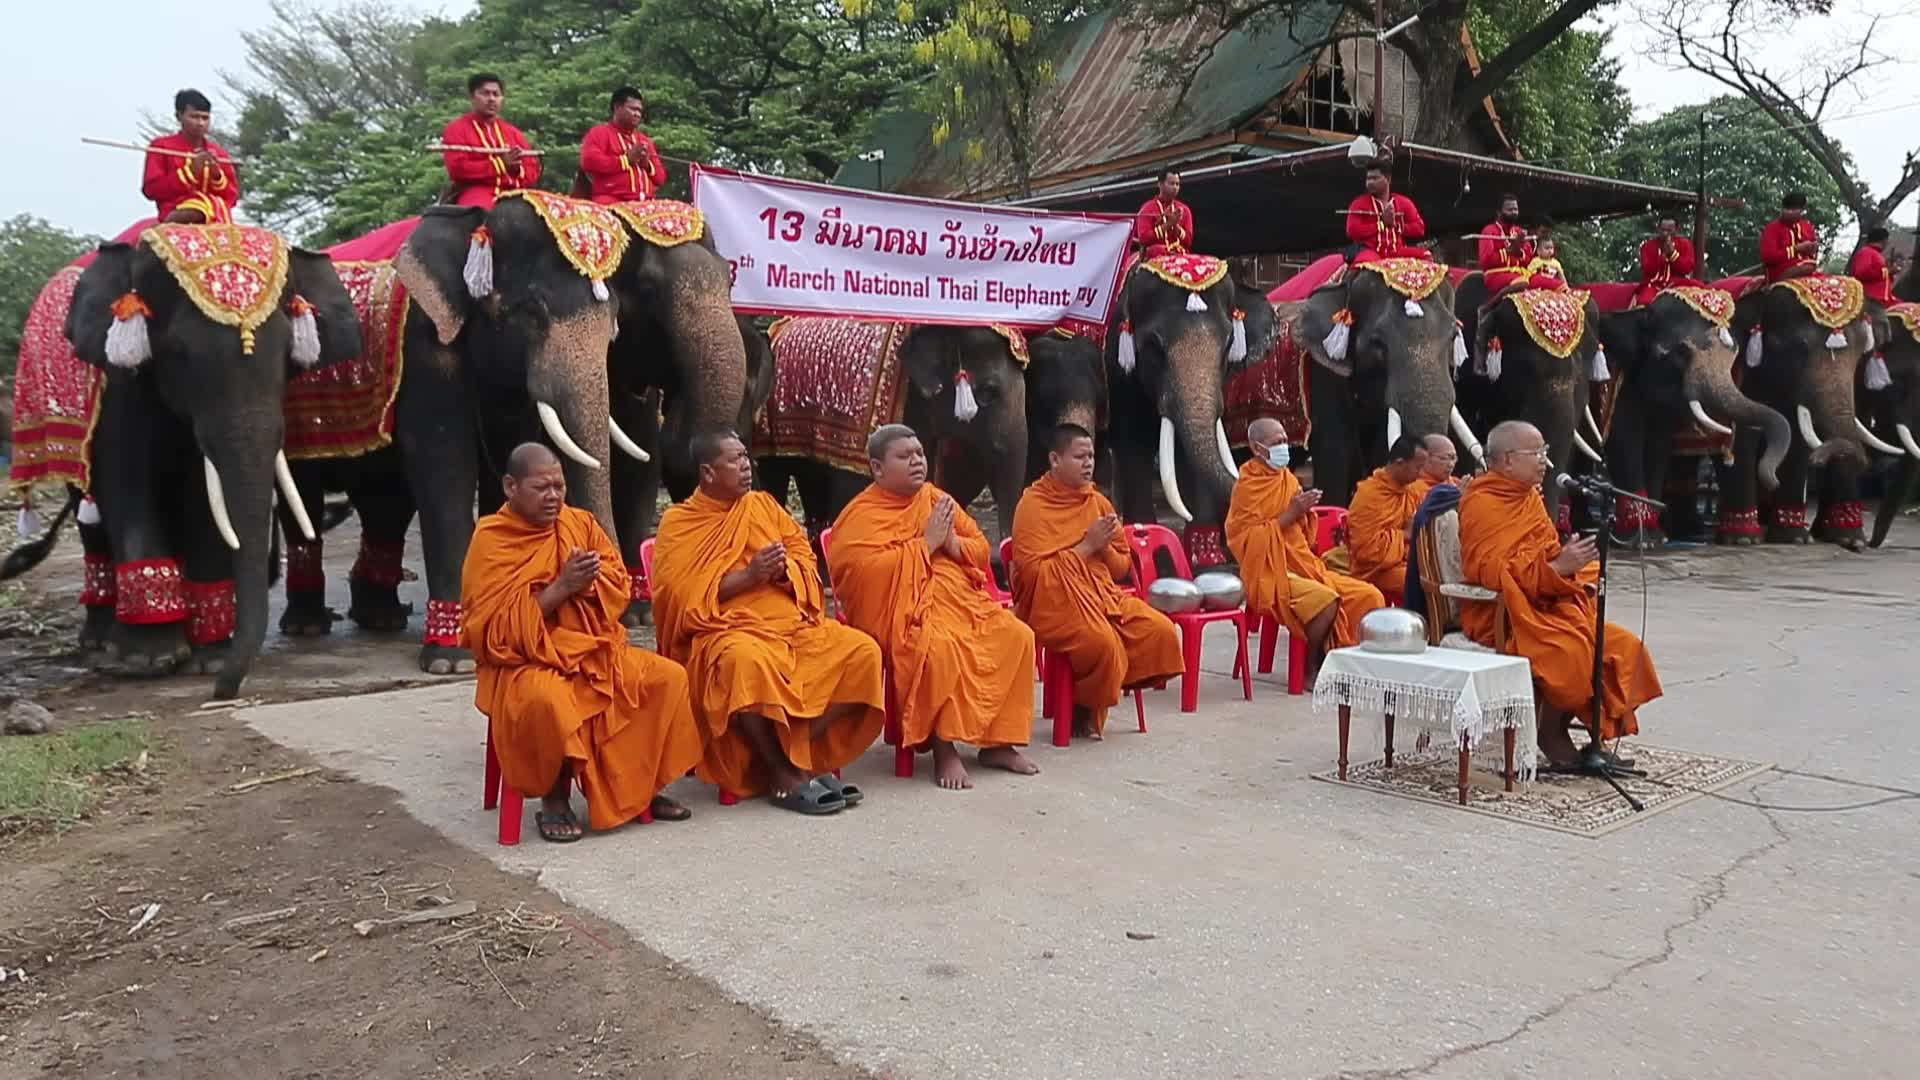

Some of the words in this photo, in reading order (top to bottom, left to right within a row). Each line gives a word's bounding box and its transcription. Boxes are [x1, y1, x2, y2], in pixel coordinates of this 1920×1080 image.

[759, 207, 805, 242] 13
[815, 207, 927, 256] มีนาคม
[939, 220, 1076, 265] วันช้างไทย
[767, 263, 835, 291] March
[844, 270, 930, 298] National
[937, 276, 978, 301] Thai
[986, 281, 1071, 309] Elephant
